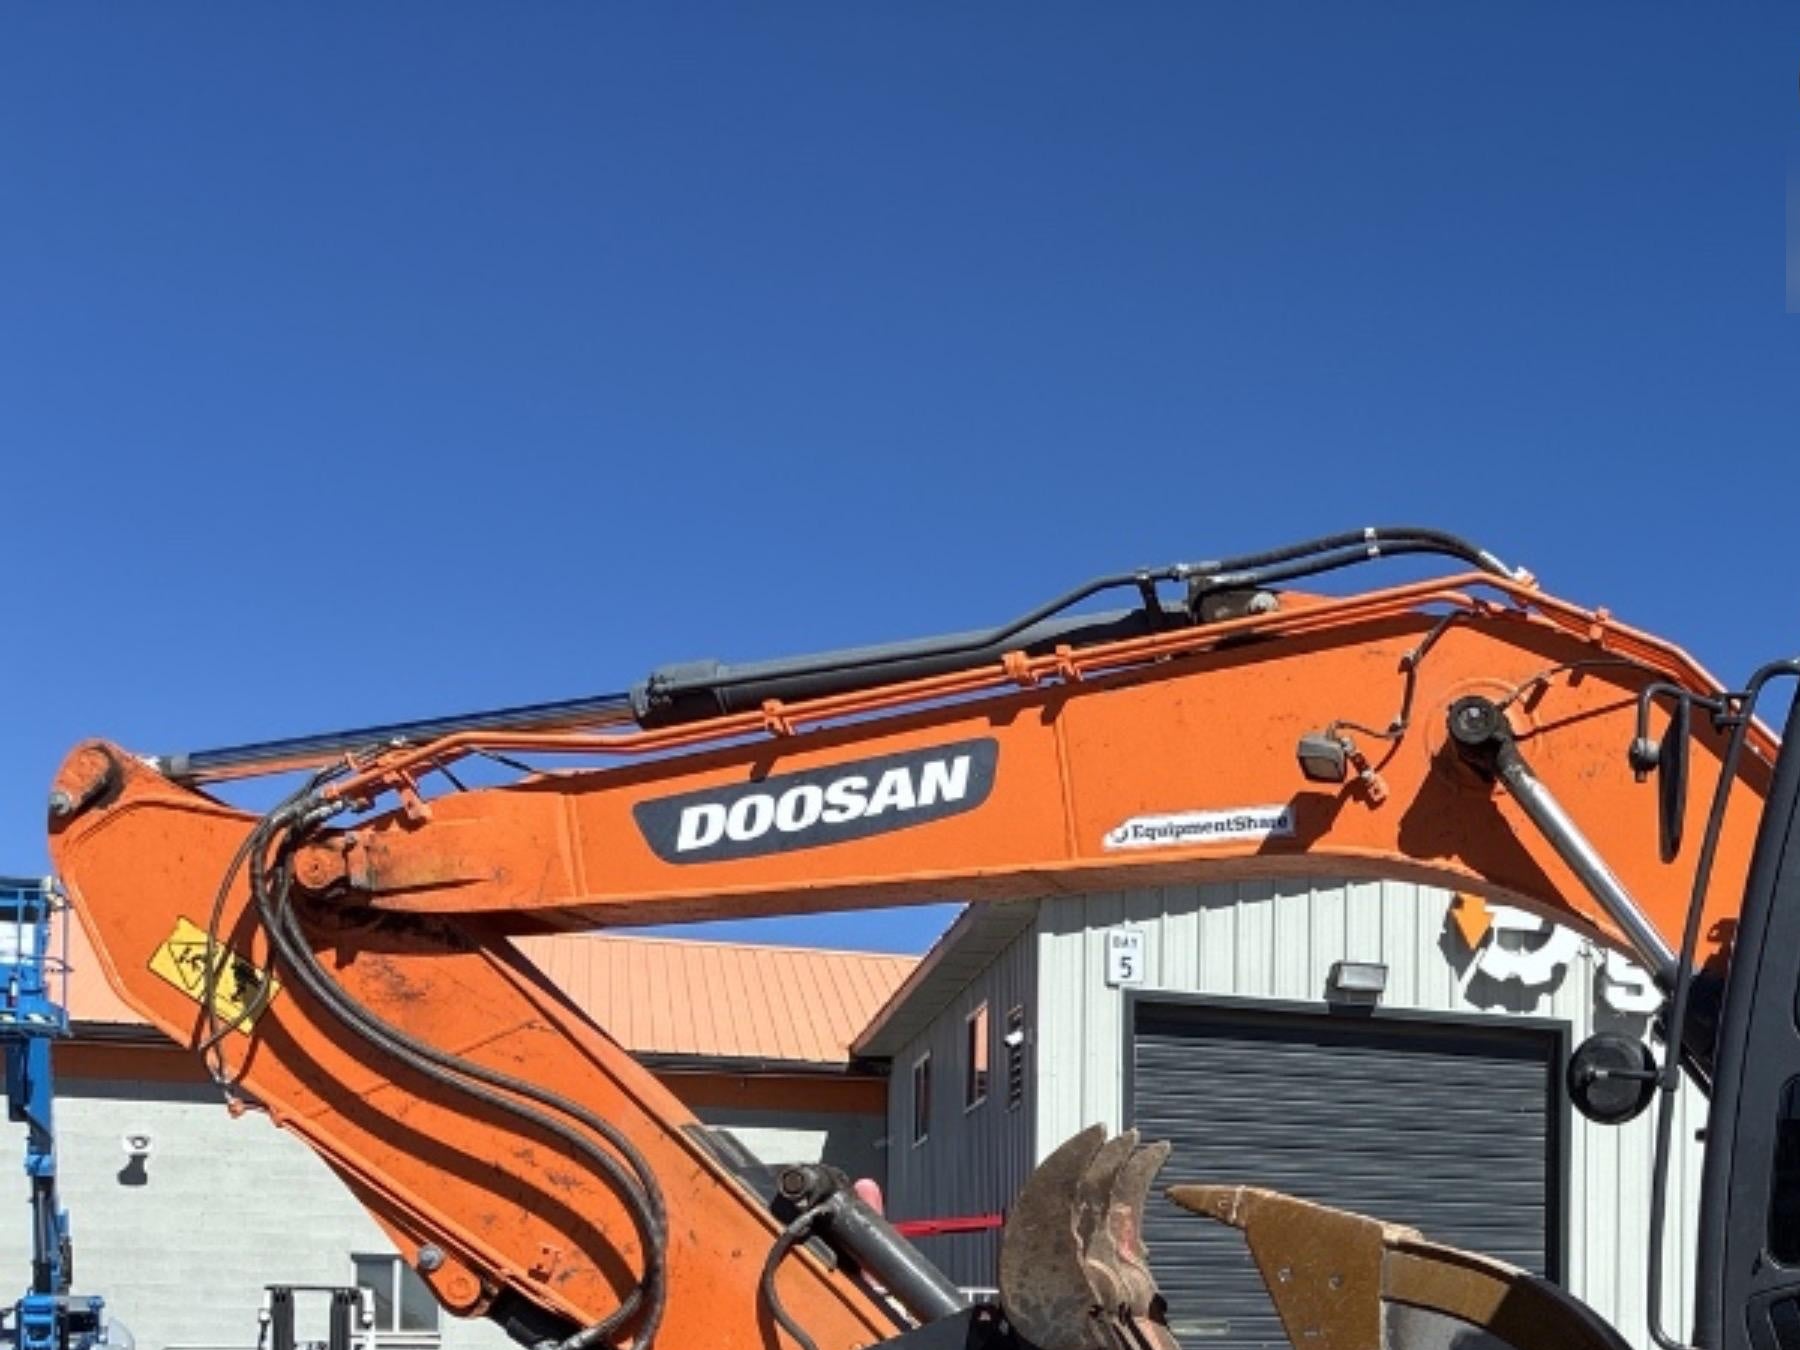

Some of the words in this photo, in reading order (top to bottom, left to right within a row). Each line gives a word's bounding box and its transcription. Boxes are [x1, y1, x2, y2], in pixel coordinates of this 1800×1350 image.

[676, 755, 971, 852] DOOSAN
[1132, 814, 1289, 840] EquipmentShare
[1120, 956, 1132, 978] 5
